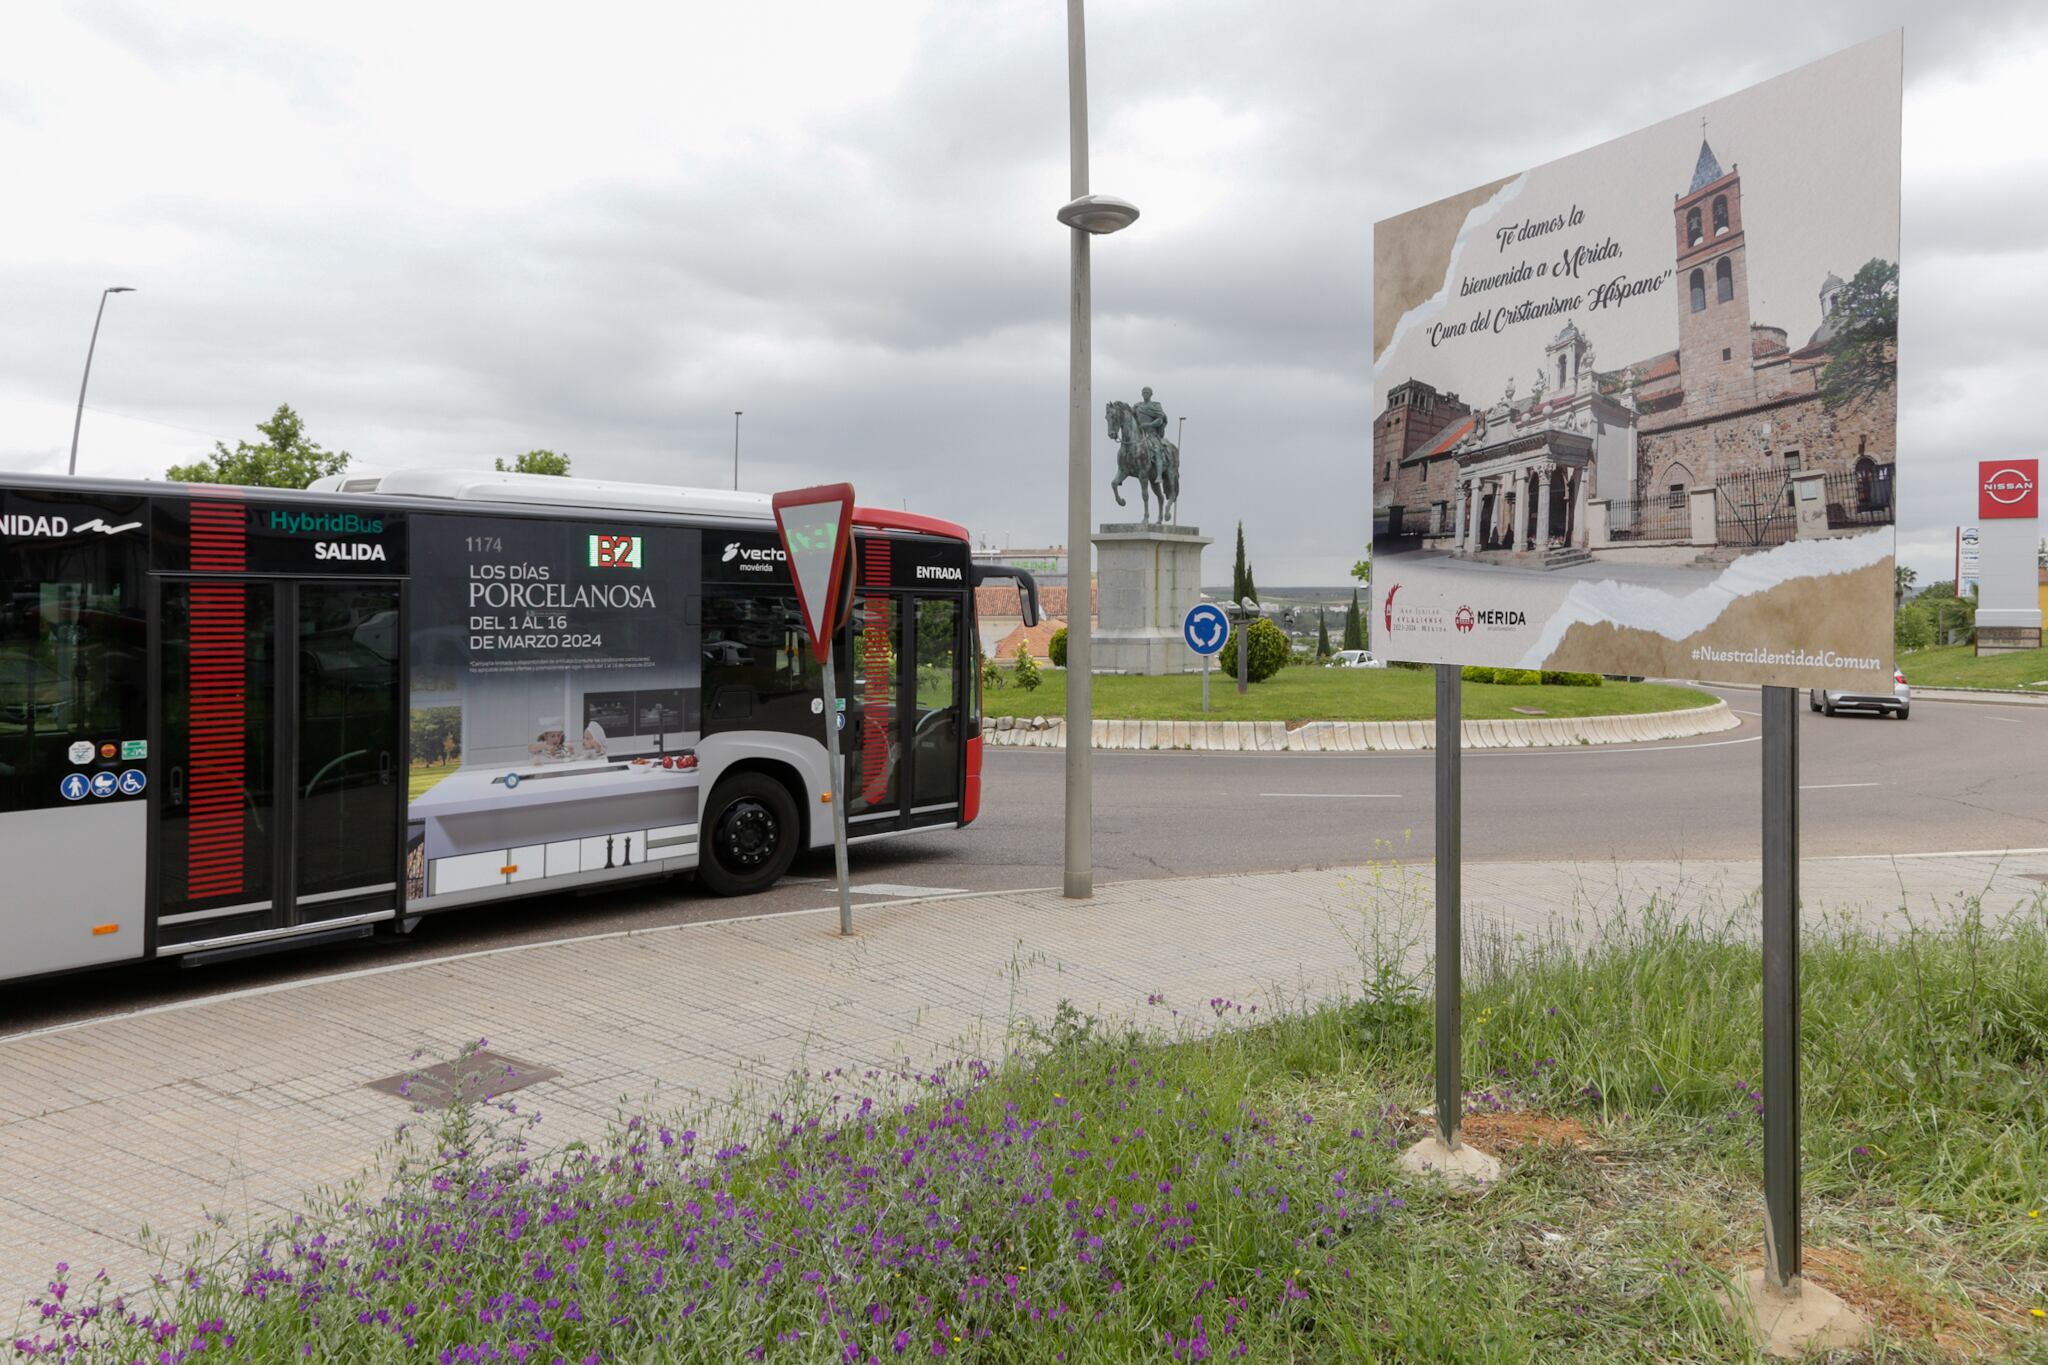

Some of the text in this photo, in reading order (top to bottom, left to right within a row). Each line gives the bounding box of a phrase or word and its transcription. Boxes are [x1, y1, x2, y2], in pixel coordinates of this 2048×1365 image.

[1496, 204, 1585, 254] Te damos la
[1460, 236, 1623, 297] bienvenida a Mérida,
[1426, 269, 1673, 348] "Cuna del Cristianismo Hispano"
[1984, 482, 2033, 490] NISSAN
[270, 511, 384, 534] HybridBus
[314, 542, 386, 562] SALIDA
[466, 536, 502, 553] 1174
[598, 535, 633, 568] B2
[470, 562, 550, 580] LOS DÍAS
[740, 563, 773, 572] movérida
[916, 565, 962, 581] ENTRADA
[469, 582, 657, 609] PORCELANOSA
[470, 615, 568, 630] DEL 1 AL 16
[1477, 608, 1527, 626] MÉRIDA
[470, 634, 602, 650] DE MARZO 2024
[1691, 645, 1881, 671] #NuestraIdentidadComun
